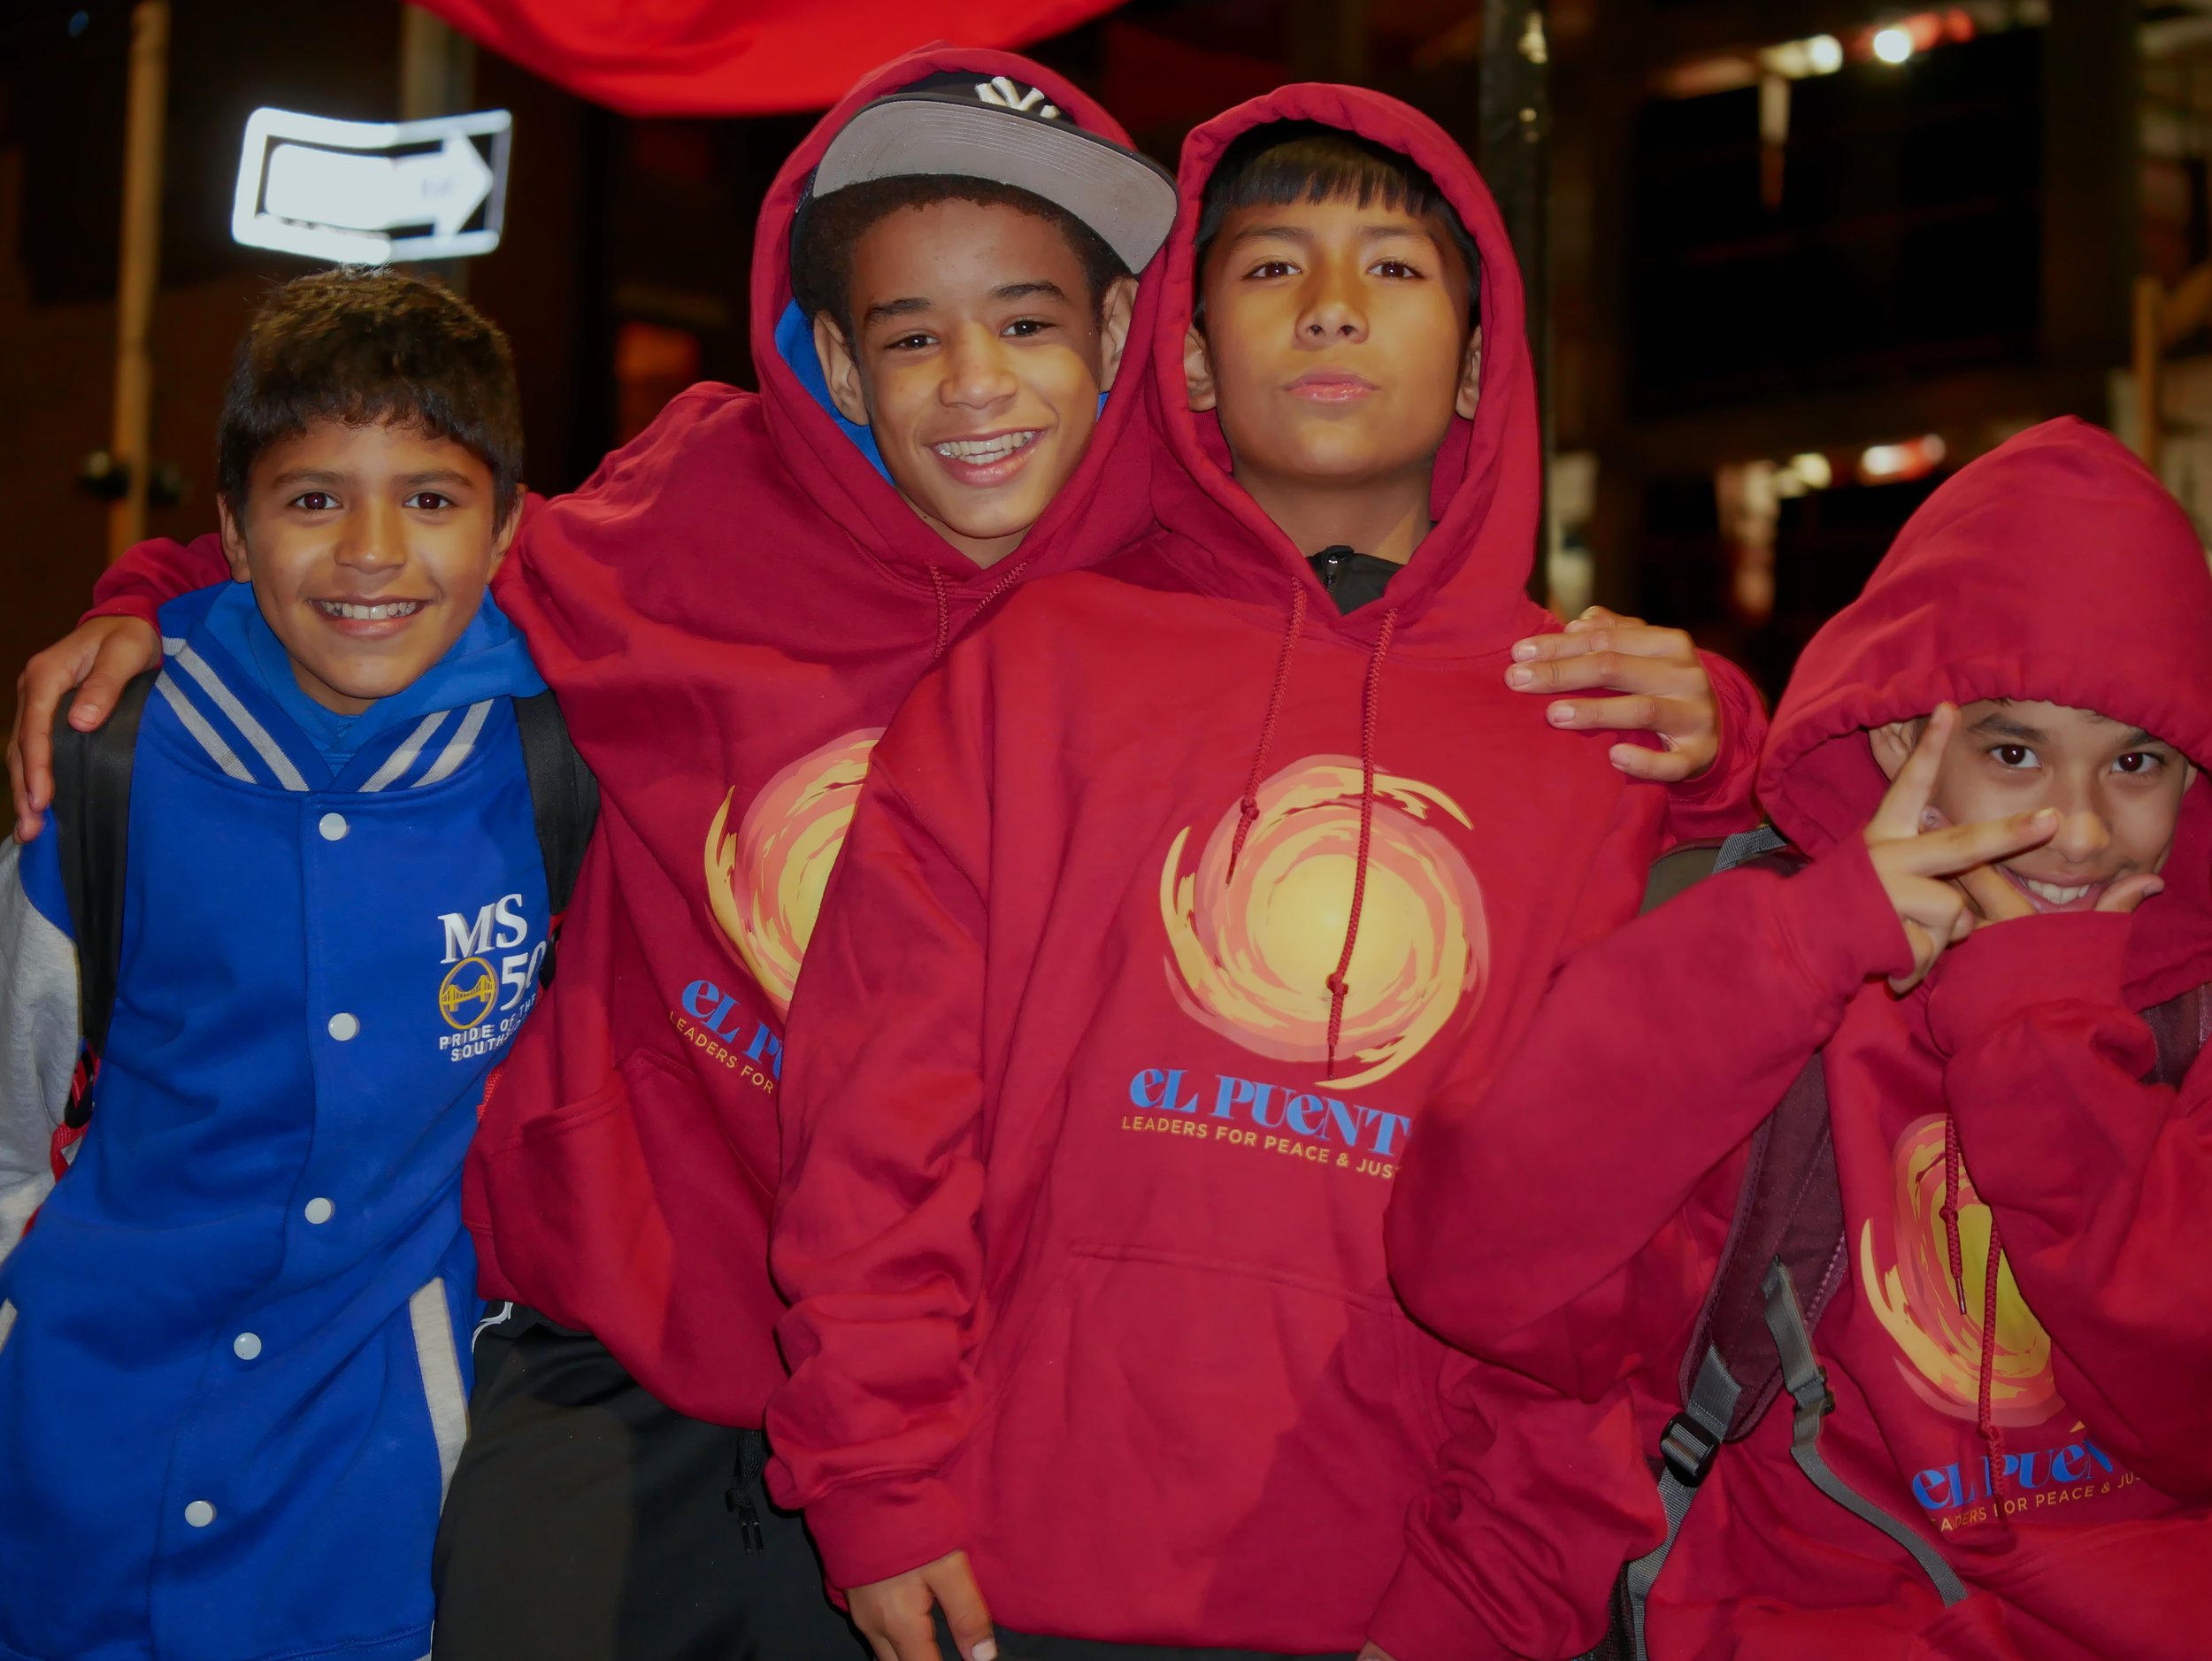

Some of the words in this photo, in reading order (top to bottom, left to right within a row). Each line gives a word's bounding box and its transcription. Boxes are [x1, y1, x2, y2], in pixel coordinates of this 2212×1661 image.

[437, 893, 528, 965] MS
[439, 1024, 495, 1050] PRIDE
[500, 1013, 516, 1033] OF
[670, 1011, 738, 1069] LEADERS
[741, 1065, 774, 1094] FOR
[1121, 1116, 1209, 1139] LEADERS
[1216, 1126, 1258, 1147] FOR
[1264, 1135, 1330, 1163] PEACE
[1336, 1152, 1349, 1168] &
[1356, 1158, 1401, 1179] JUS
[2036, 1485, 2095, 1508] PEACE
[2101, 1481, 2110, 1495] &
[2117, 1471, 2141, 1489] JU
